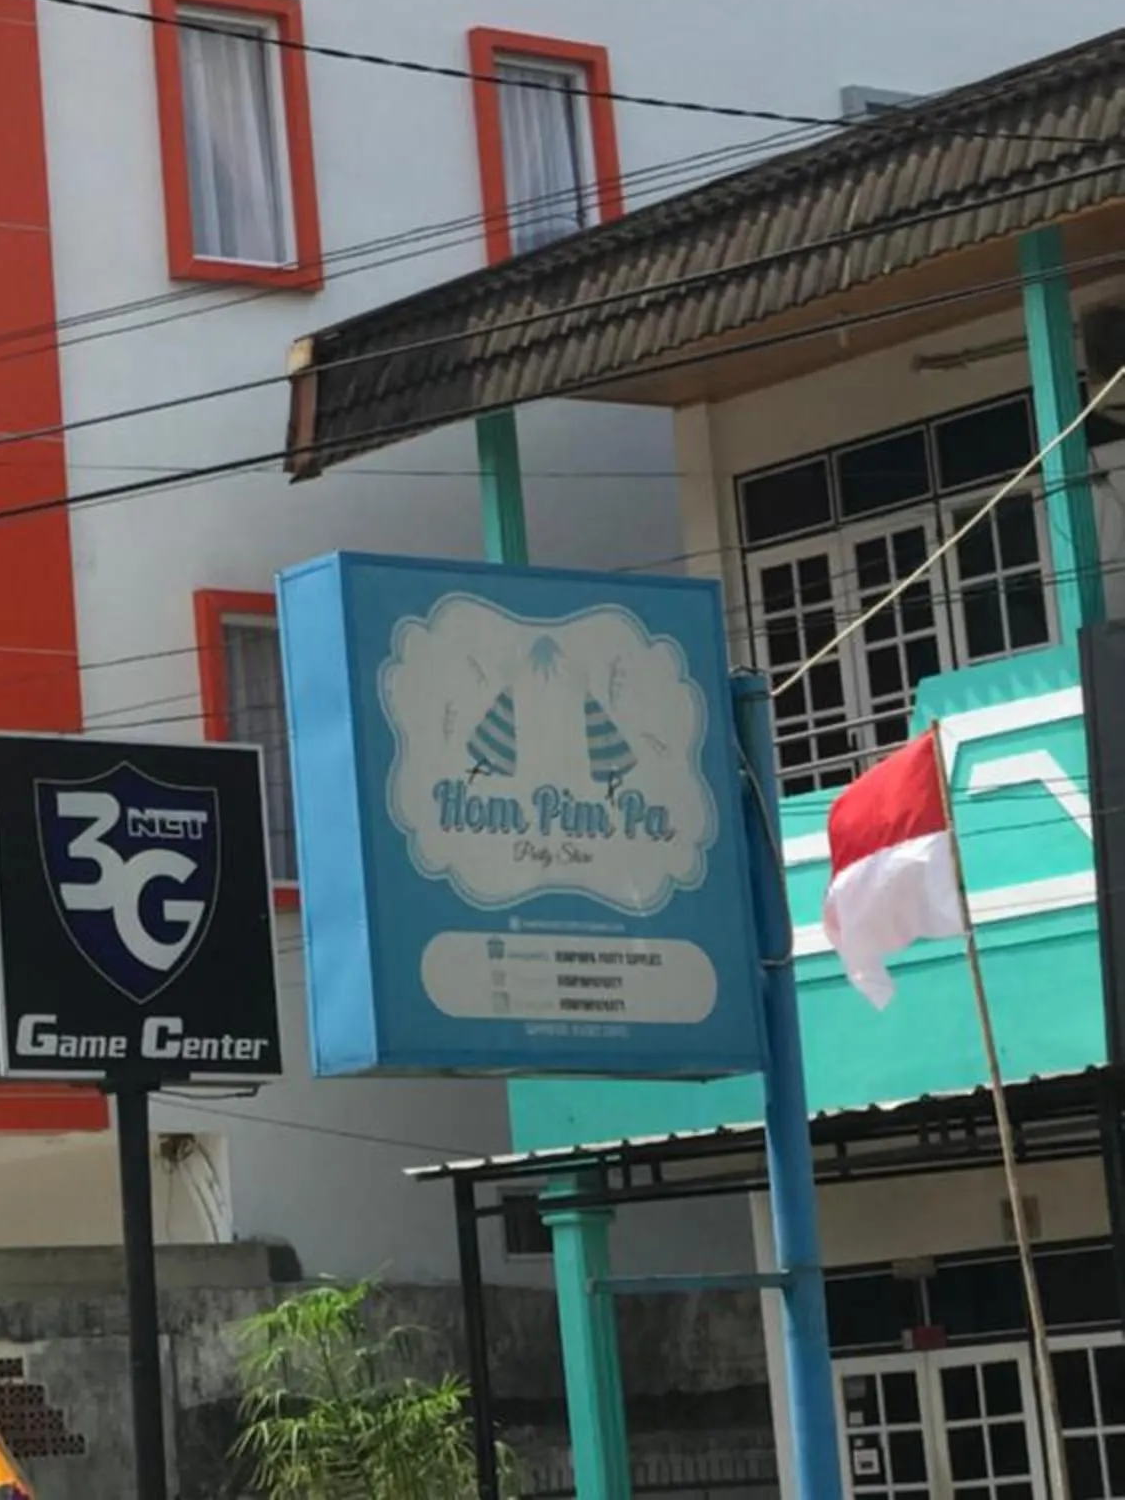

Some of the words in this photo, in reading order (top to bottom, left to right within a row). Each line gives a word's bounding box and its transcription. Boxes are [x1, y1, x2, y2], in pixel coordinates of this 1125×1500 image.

[127, 807, 209, 840] NET
[433, 779, 530, 835] Hom
[532, 784, 617, 840] Pim
[618, 789, 677, 842] Pa
[16, 1014, 127, 1059] Game
[141, 1016, 269, 1061] Center
